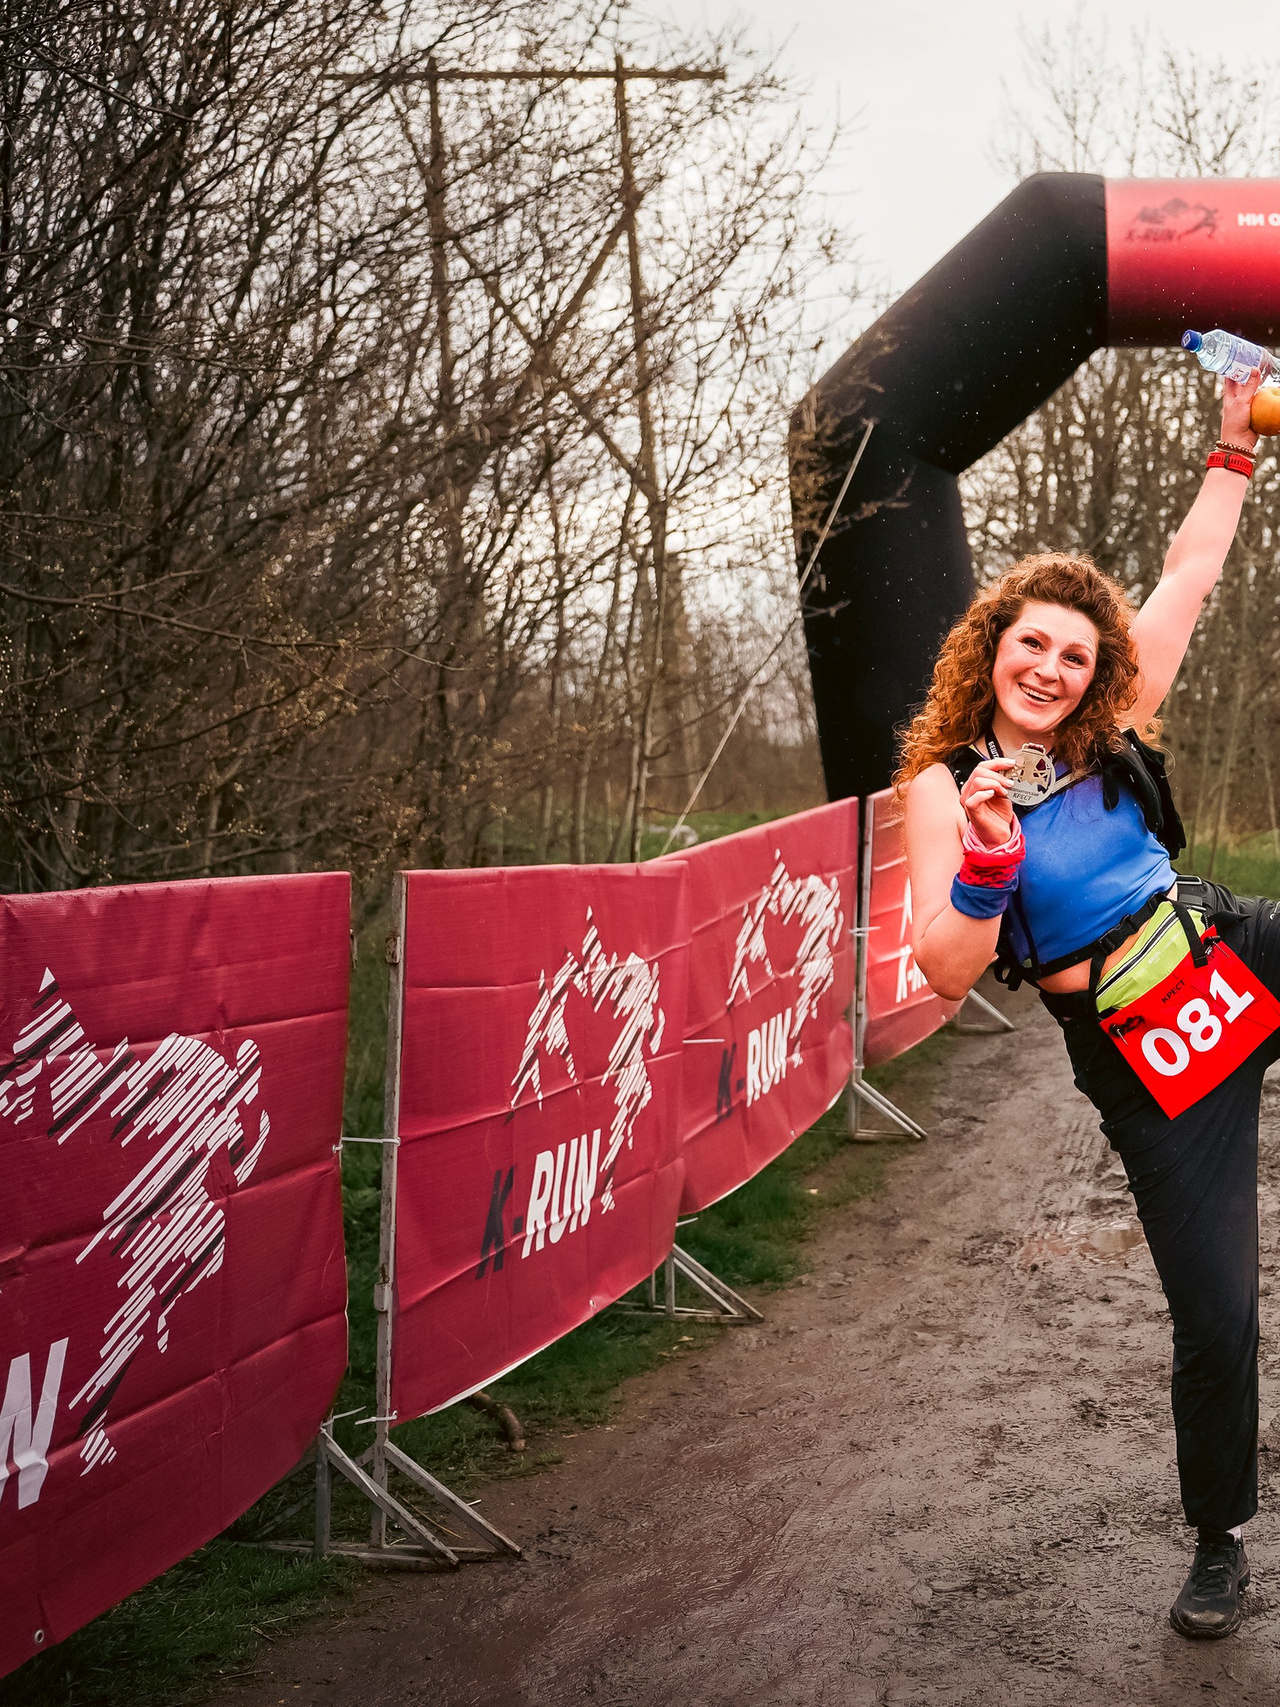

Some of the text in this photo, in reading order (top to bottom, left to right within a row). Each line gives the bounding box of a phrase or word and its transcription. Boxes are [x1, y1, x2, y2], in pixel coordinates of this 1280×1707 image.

[1237, 213, 1265, 227] НИ
[1141, 968, 1255, 1077] 081
[474, 1128, 601, 1281] K-RUN
